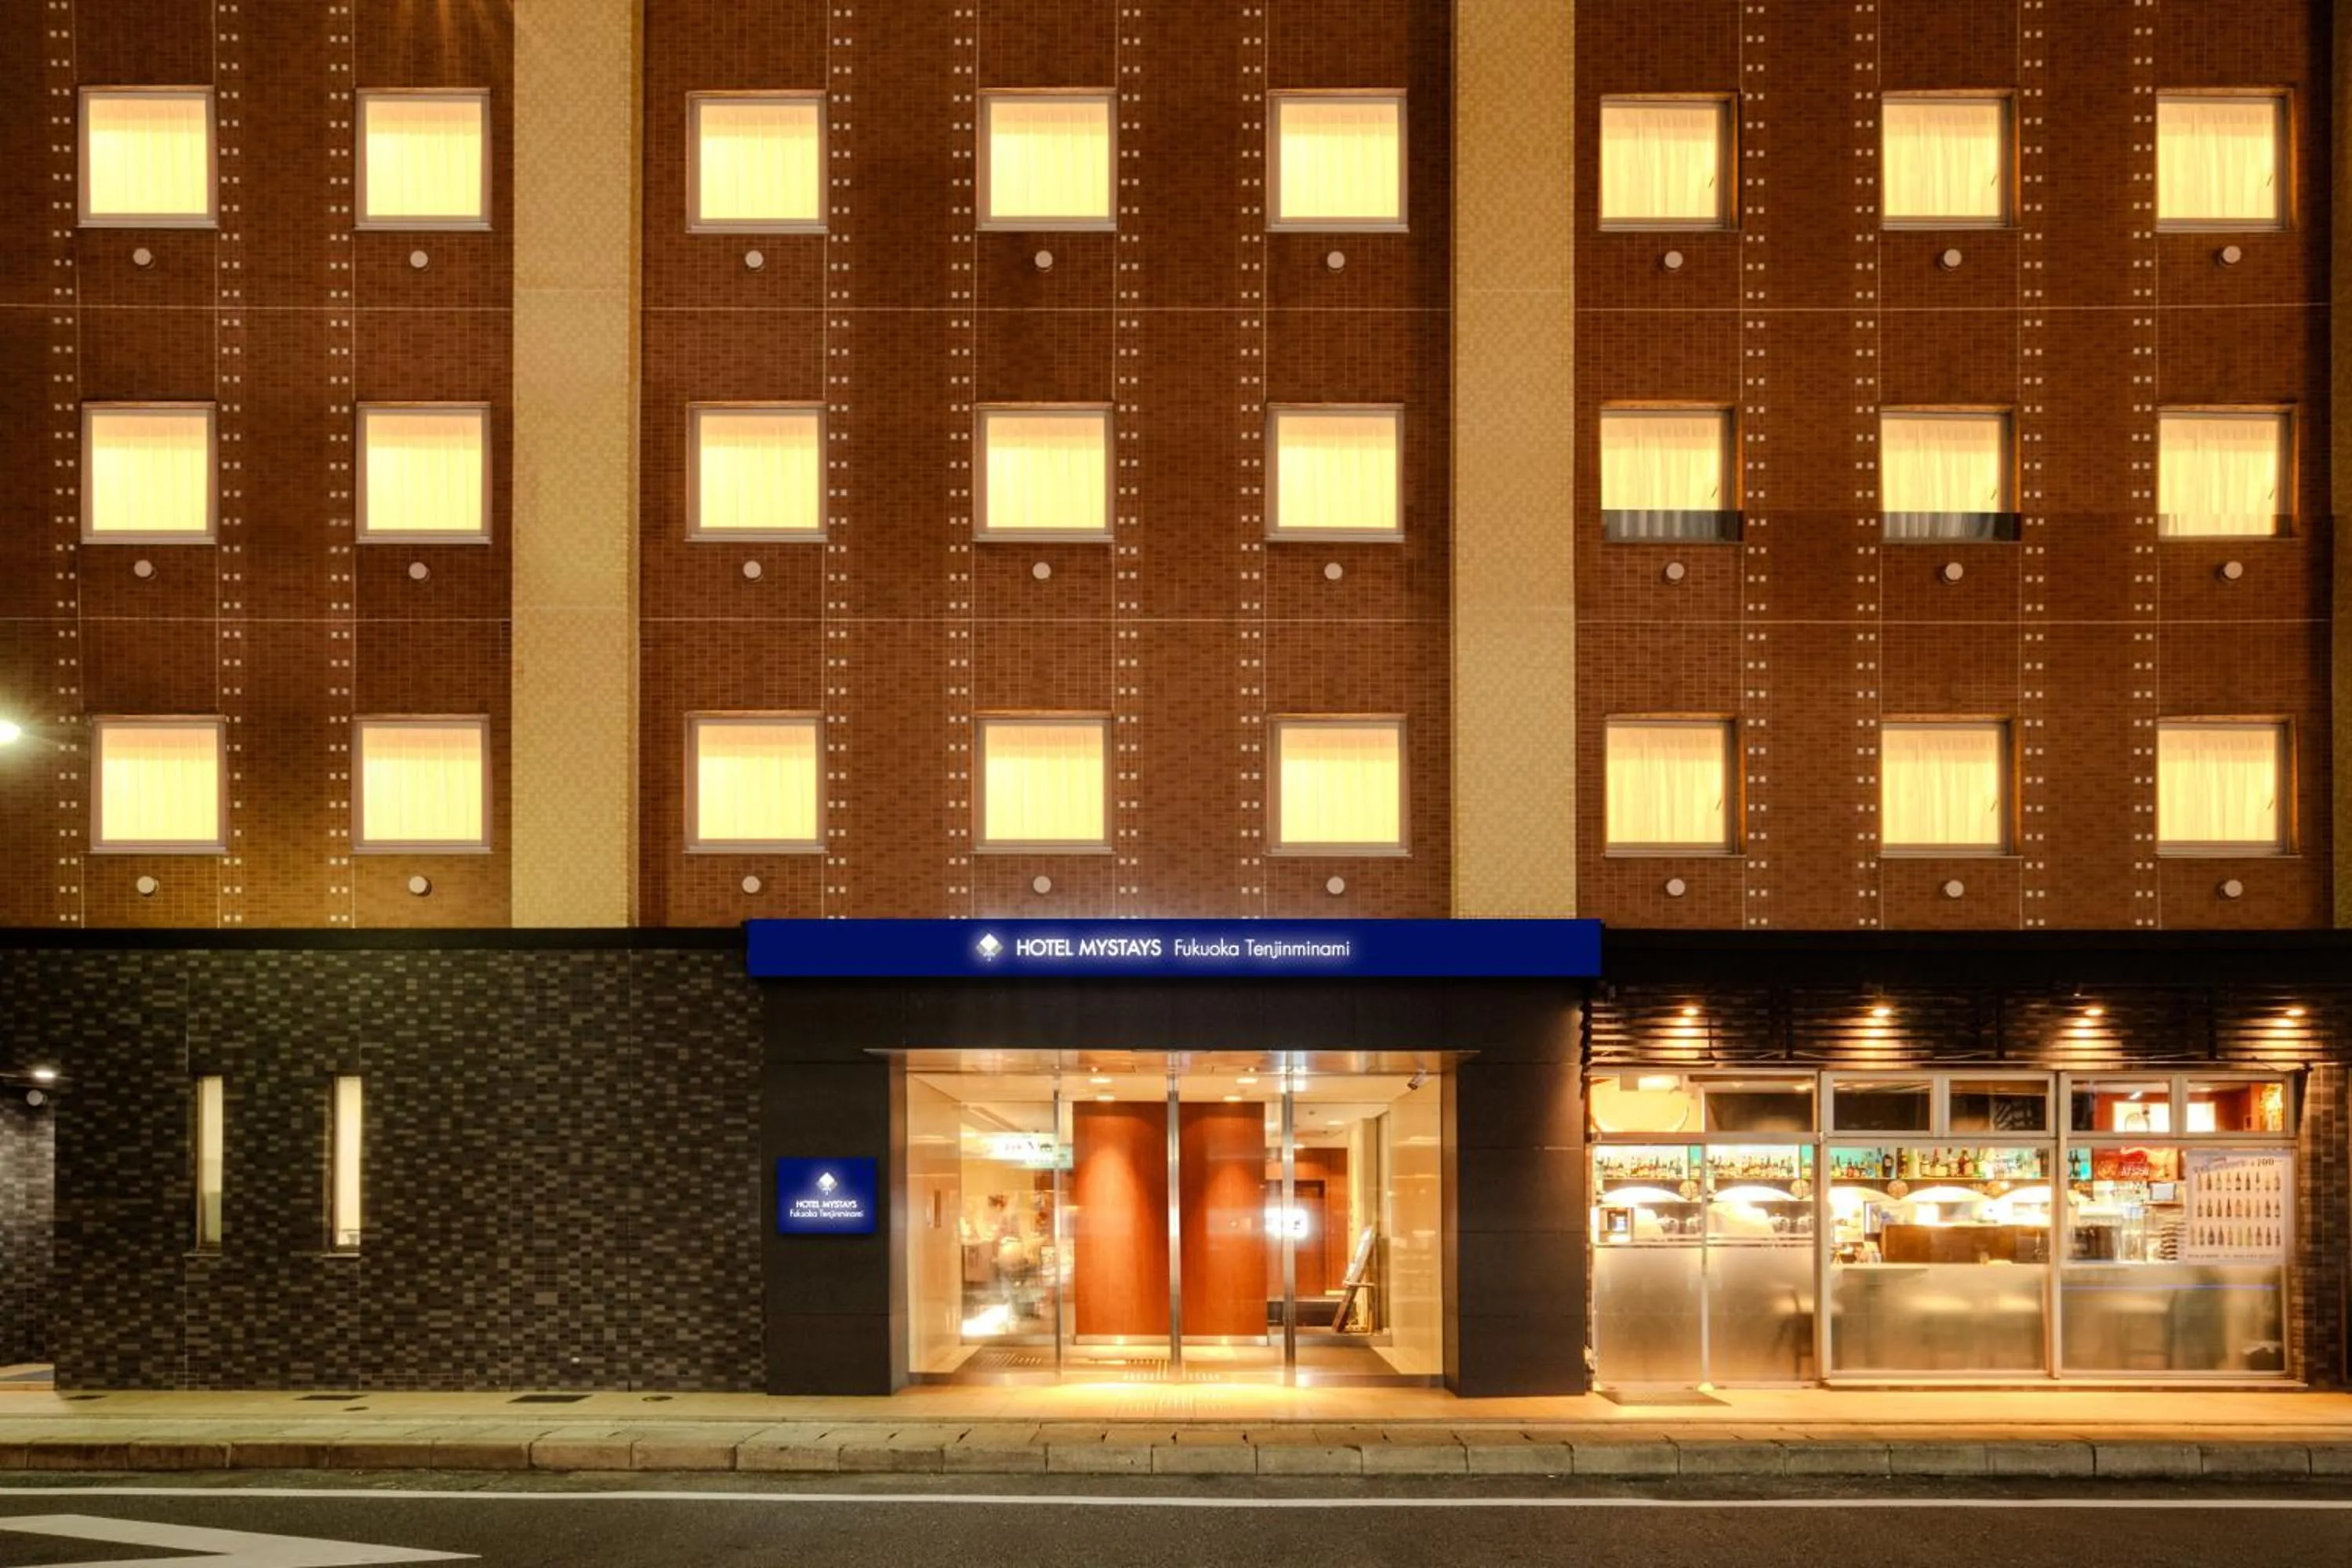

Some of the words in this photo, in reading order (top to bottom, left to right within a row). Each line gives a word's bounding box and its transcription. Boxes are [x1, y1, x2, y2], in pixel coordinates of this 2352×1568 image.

[1016, 939, 1074, 956] HOTEL
[1078, 939, 1162, 956] MYSTAYS
[1174, 938, 1240, 956] Fukuoka
[1244, 938, 1351, 959] Tenjinminami
[796, 1200, 819, 1208] HOTEL
[822, 1200, 858, 1208] MYSTAYS
